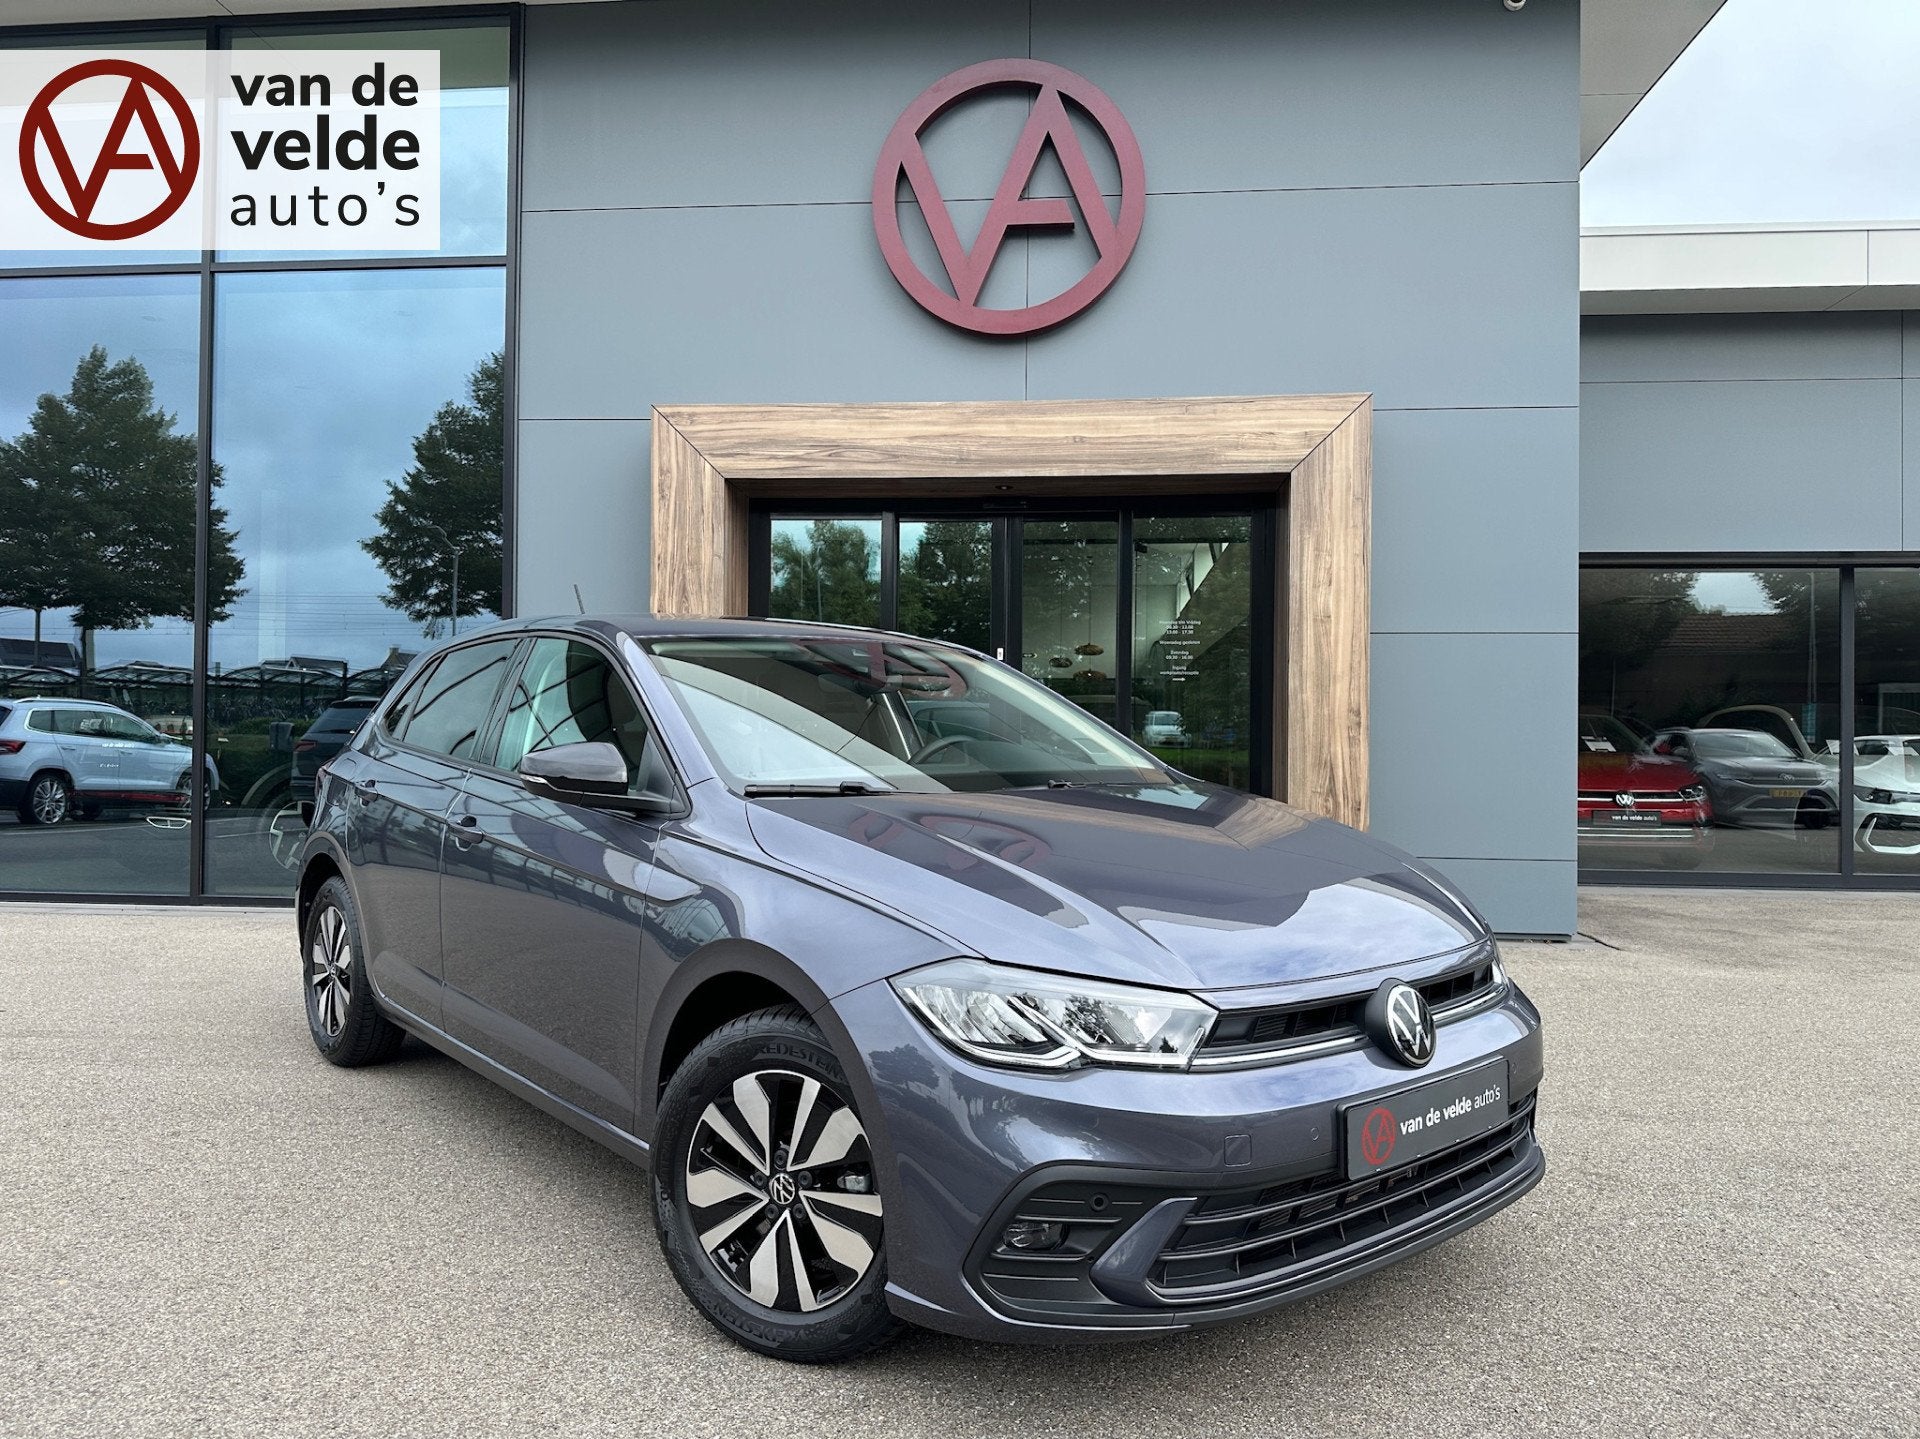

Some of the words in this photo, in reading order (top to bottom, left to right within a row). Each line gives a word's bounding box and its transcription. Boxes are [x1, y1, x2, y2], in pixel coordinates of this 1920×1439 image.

[1400, 1115, 1423, 1136] van
[1425, 1107, 1441, 1127] de
[1442, 1096, 1472, 1121] velde
[1474, 1084, 1501, 1109] auto's
